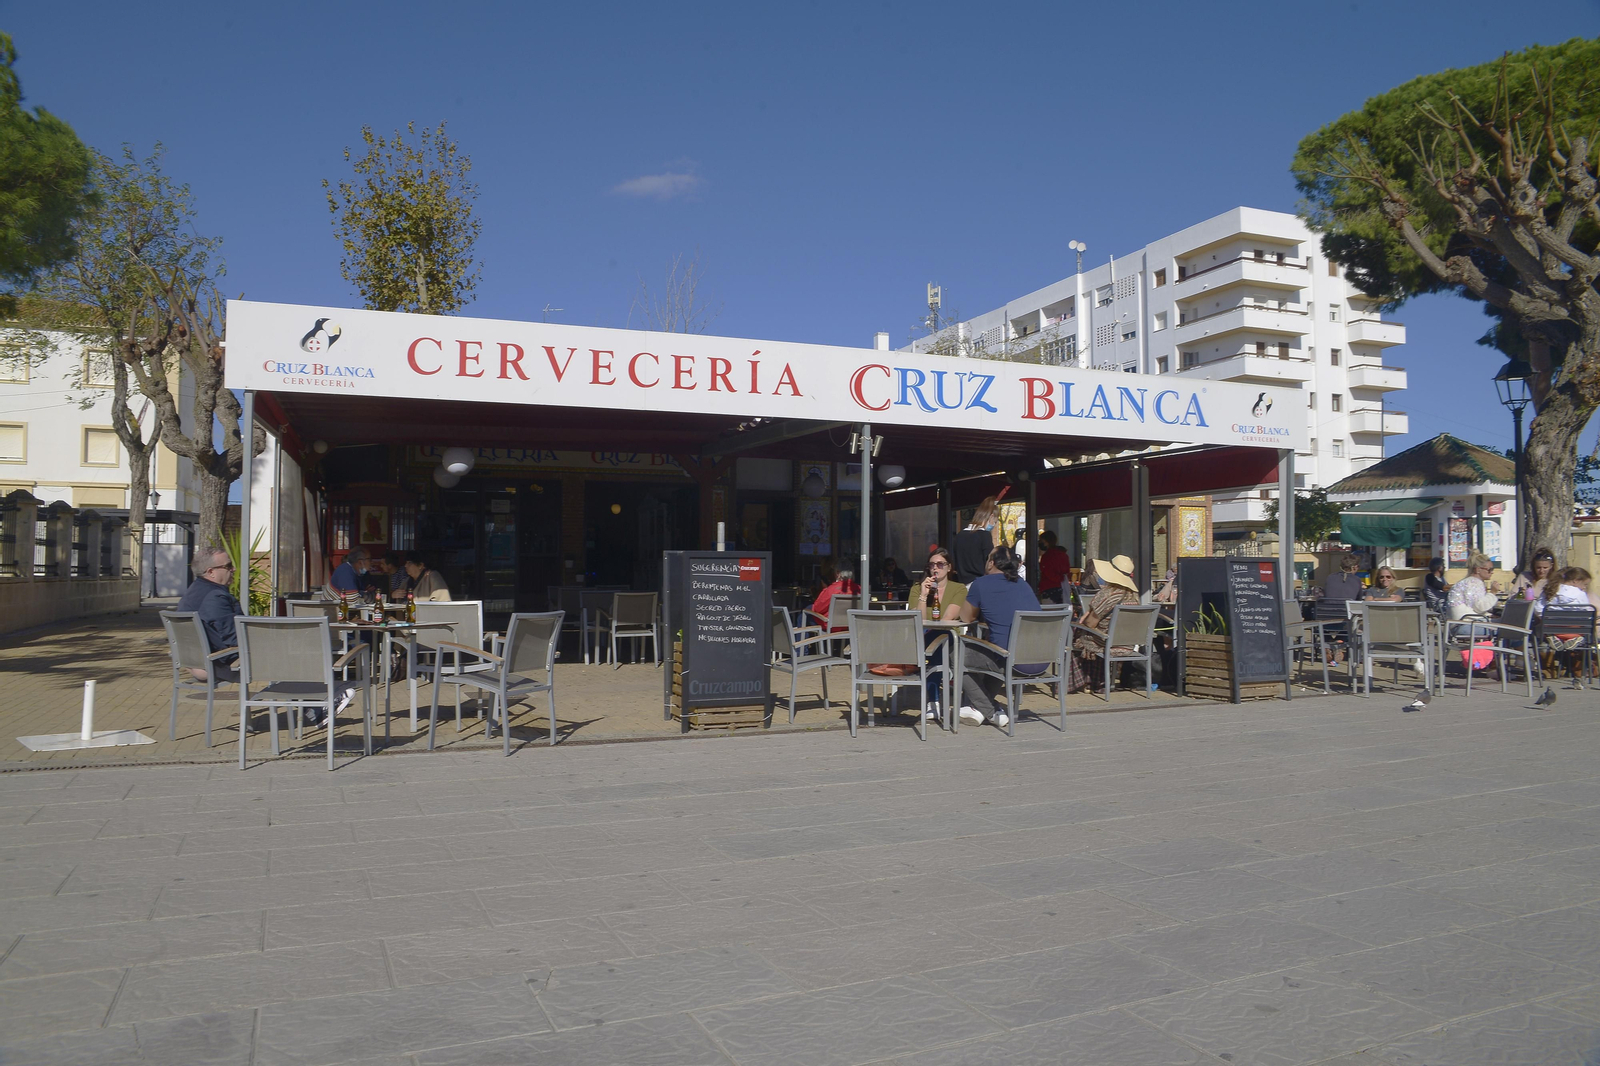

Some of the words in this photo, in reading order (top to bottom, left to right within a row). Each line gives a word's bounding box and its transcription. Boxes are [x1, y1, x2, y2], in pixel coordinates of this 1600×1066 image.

[263, 360, 311, 375] CRUZ
[312, 363, 375, 378] BLANCA
[407, 337, 803, 397] CERVECERÍA
[283, 377, 355, 388] CERVECERÍA
[850, 364, 998, 413] CRUZ
[1019, 377, 1210, 427] BLANCA
[1231, 423, 1256, 435] CRUZ
[1257, 425, 1290, 436] BLANCA
[689, 679, 762, 695] Cruzcampo
